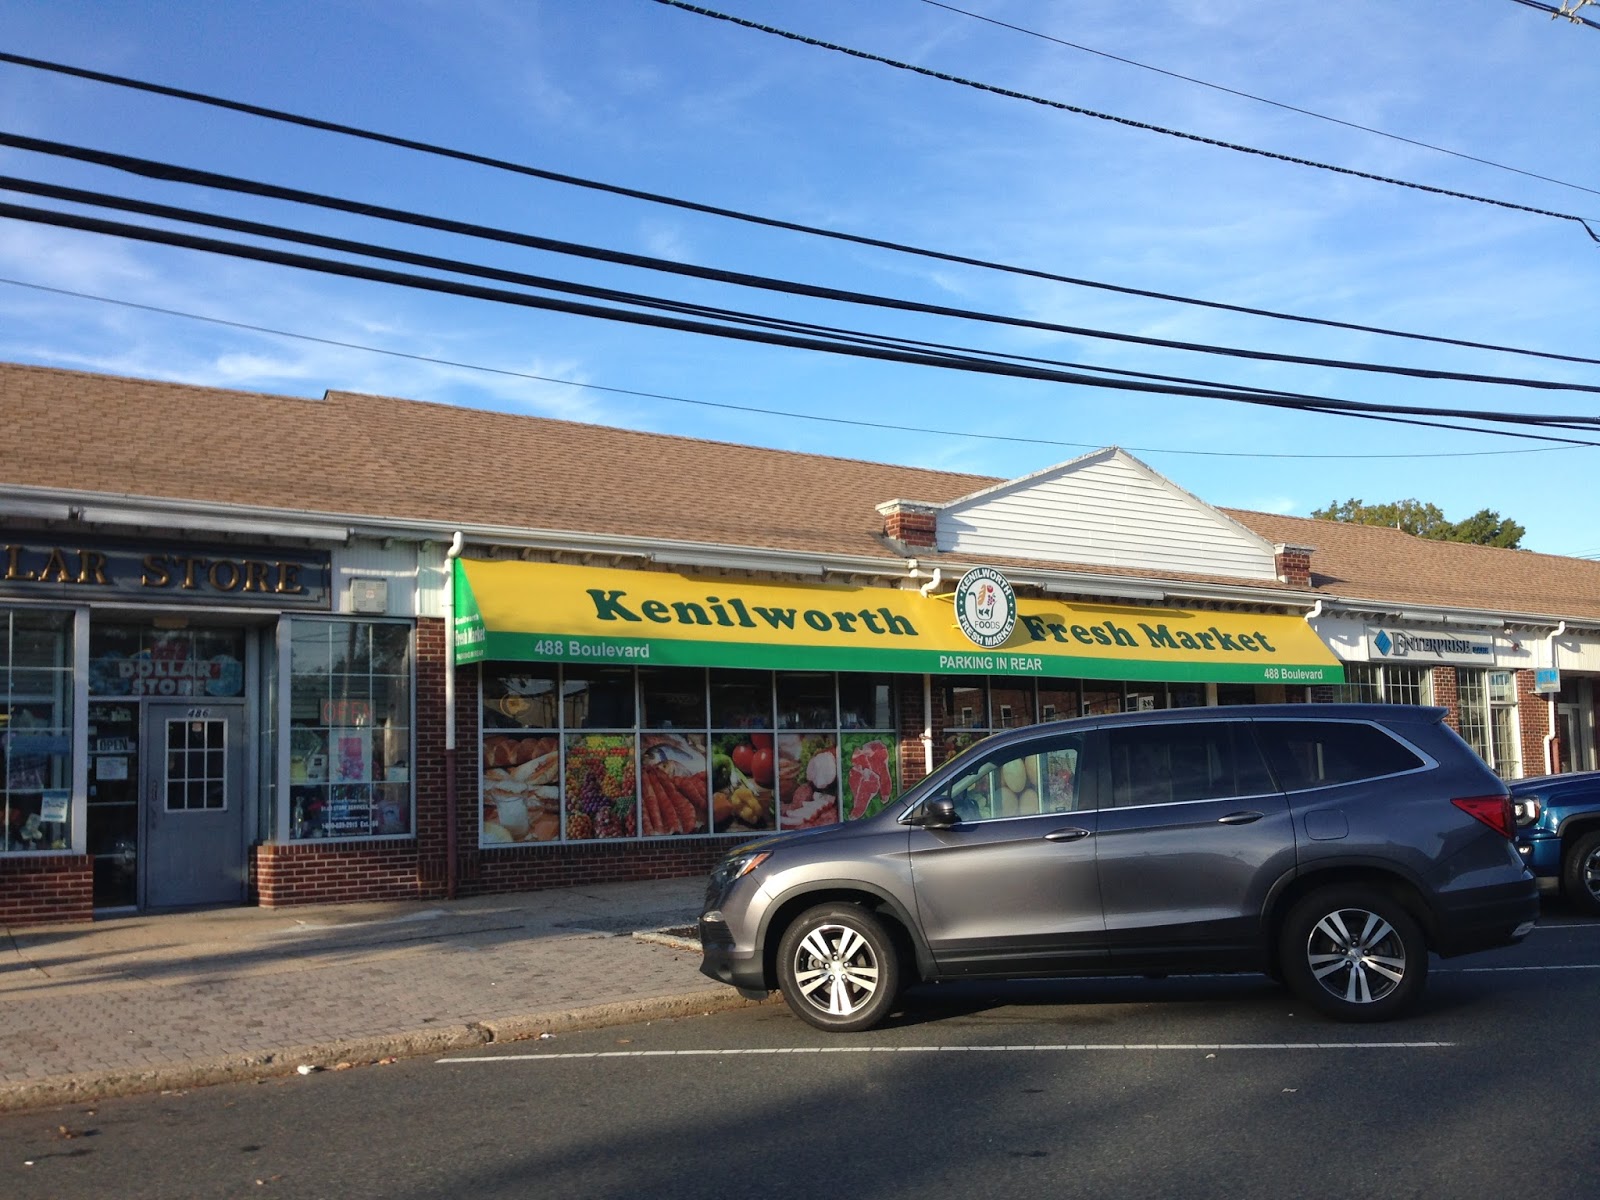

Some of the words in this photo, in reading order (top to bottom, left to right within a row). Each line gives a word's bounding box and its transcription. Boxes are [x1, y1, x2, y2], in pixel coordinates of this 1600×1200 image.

[141, 552, 305, 593] STORE
[960, 568, 1012, 596] KENILWORTH
[586, 589, 919, 636] Kenilworth
[959, 614, 983, 645] FRESH
[985, 615, 1014, 646] MARKET
[974, 620, 1000, 629] FOODS
[1018, 615, 1138, 647] Fresh
[1137, 622, 1276, 653] Market
[535, 639, 564, 655] 488
[568, 641, 650, 658] Boulevard
[119, 659, 212, 678] DOLLAR
[939, 655, 993, 669] PARKING
[996, 657, 1007, 669] IN
[1011, 658, 1042, 670] REAR
[1263, 668, 1279, 679] 488
[1281, 669, 1323, 680] Boulevard
[132, 679, 206, 695] STORE
[187, 708, 209, 718] 486
[100, 738, 128, 751] OPEN
